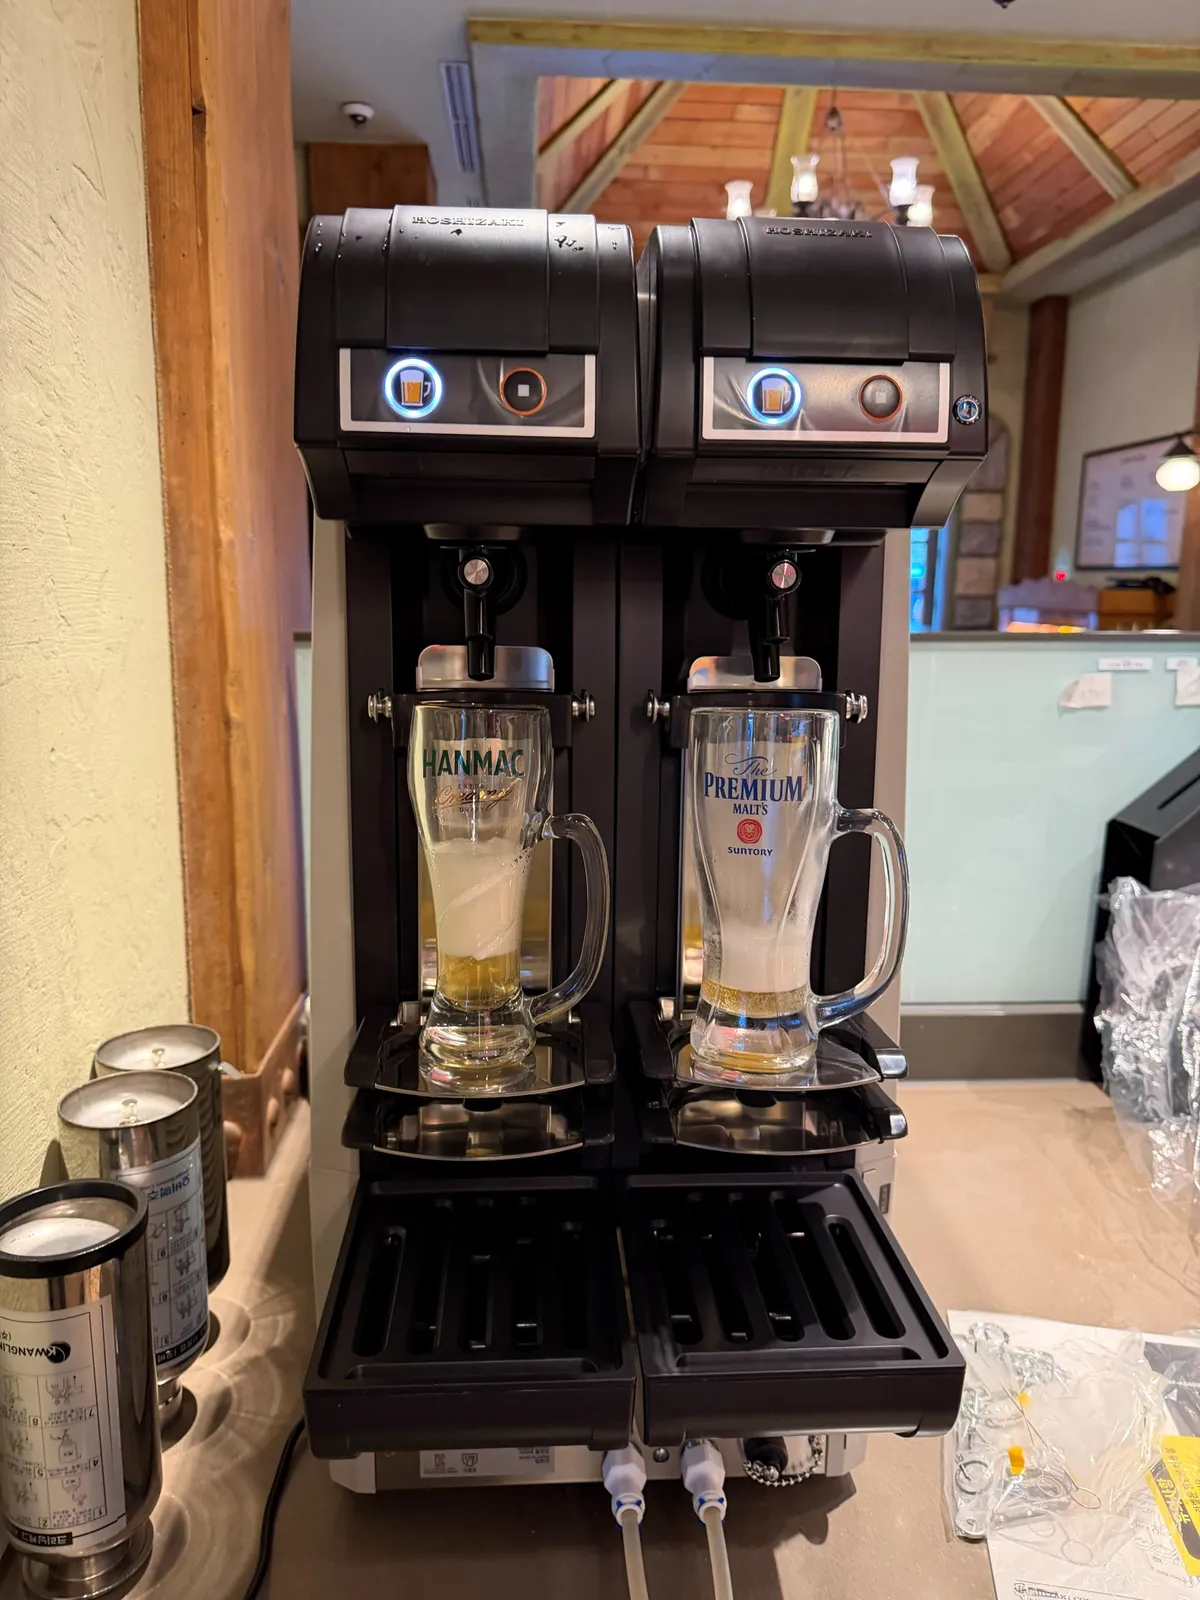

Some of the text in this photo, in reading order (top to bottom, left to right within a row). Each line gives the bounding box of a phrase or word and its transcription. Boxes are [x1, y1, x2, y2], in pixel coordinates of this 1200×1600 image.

[411, 216, 525, 227] HOSHIZAKI
[765, 226, 873, 238] HOSHIZAKI
[422, 748, 525, 778] HANMAC
[724, 753, 778, 777] The
[703, 771, 803, 802] PREMIUM
[434, 784, 513, 811] Creamy
[732, 802, 769, 816] MALT'S
[727, 846, 774, 857] SUNTORY
